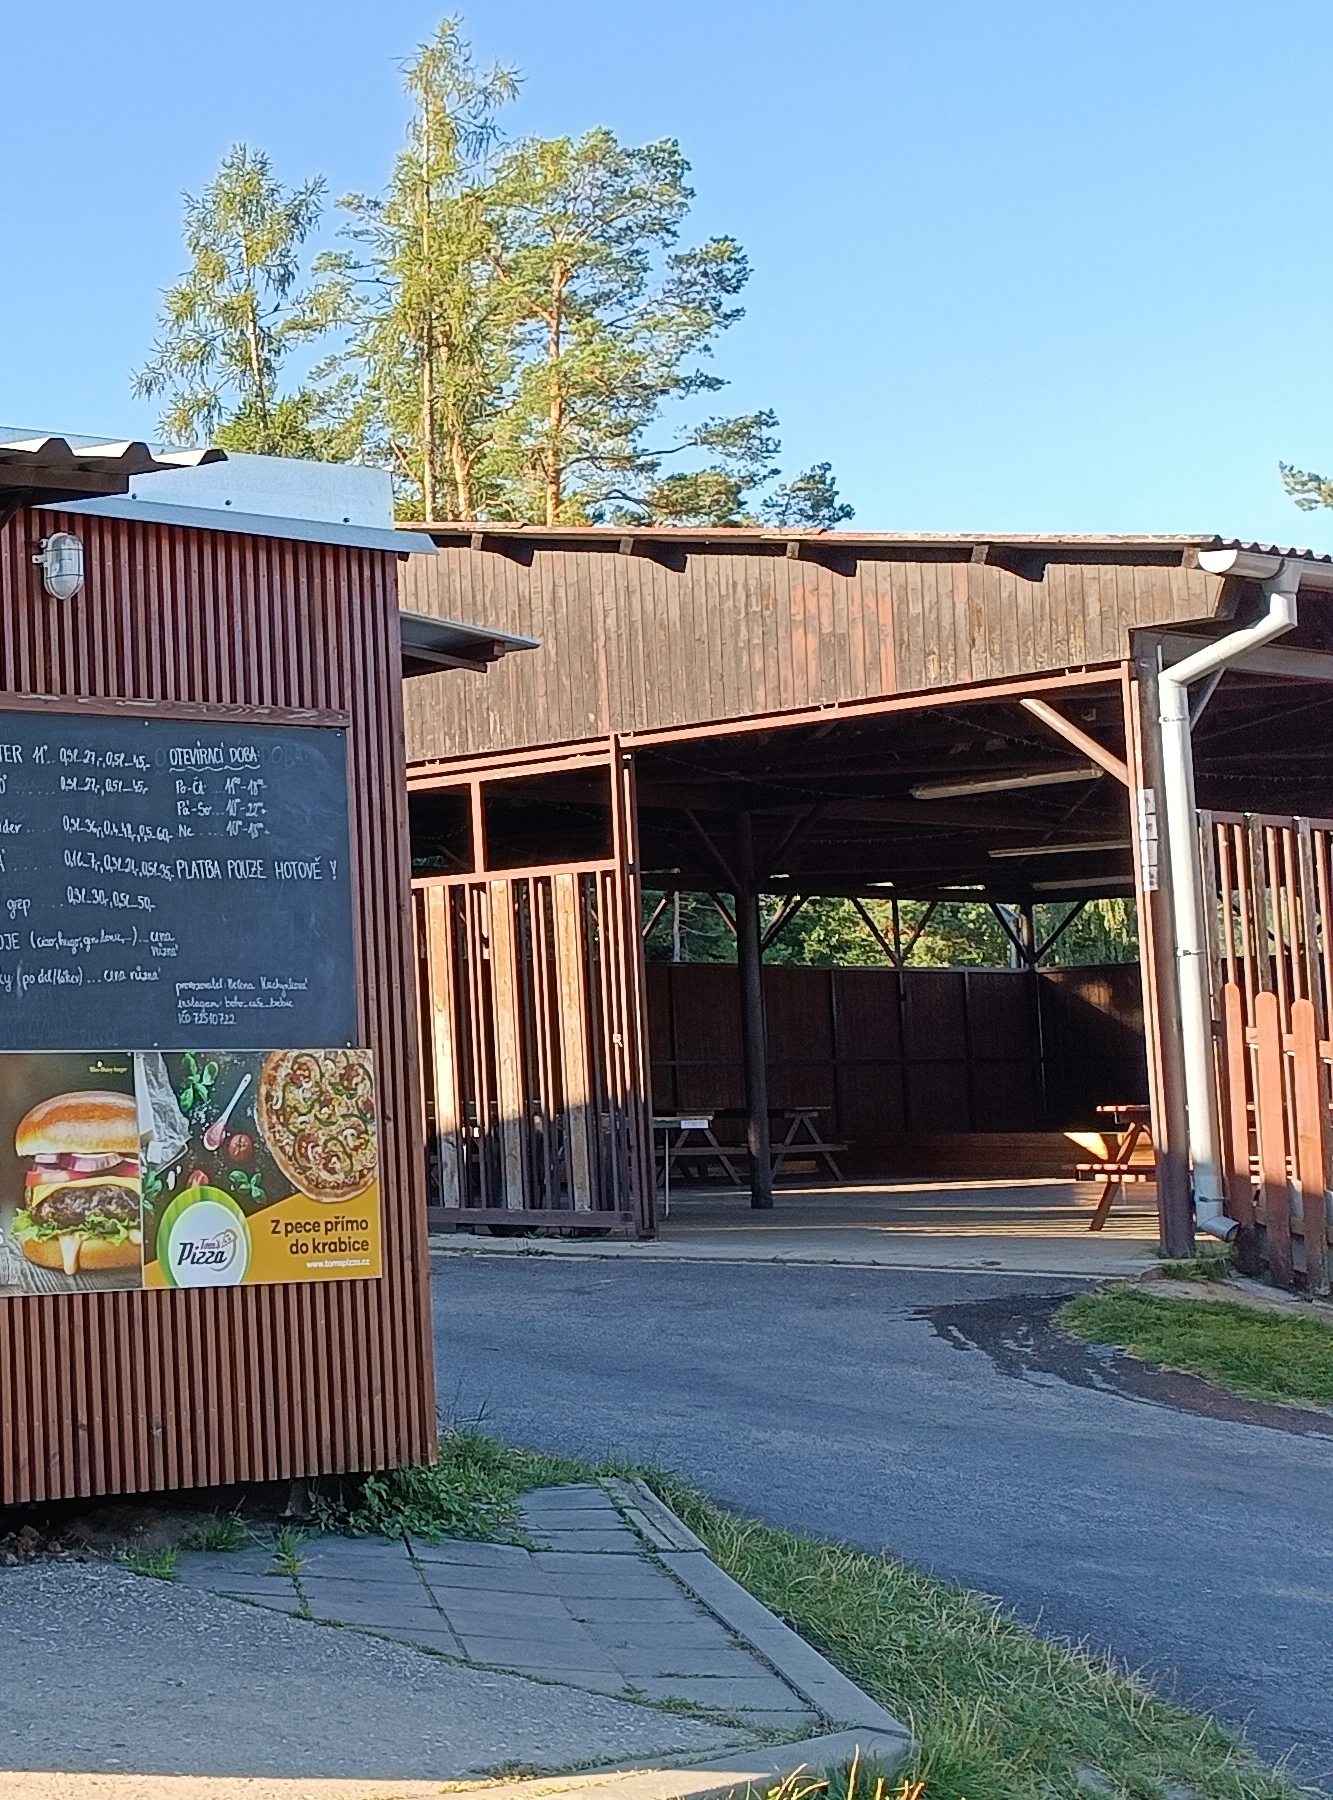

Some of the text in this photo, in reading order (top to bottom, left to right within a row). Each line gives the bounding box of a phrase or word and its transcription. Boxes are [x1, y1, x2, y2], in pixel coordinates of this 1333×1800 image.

[169, 740, 224, 766] OTEVÍRACÍ
[175, 859, 222, 880] PLATBA
[227, 859, 267, 879] POUZE
[274, 855, 322, 880] HOTOVĚ
[270, 1215, 370, 1238] Z pece přímo
[177, 1242, 229, 1267] Pizza
[289, 1236, 370, 1255] do krabice
